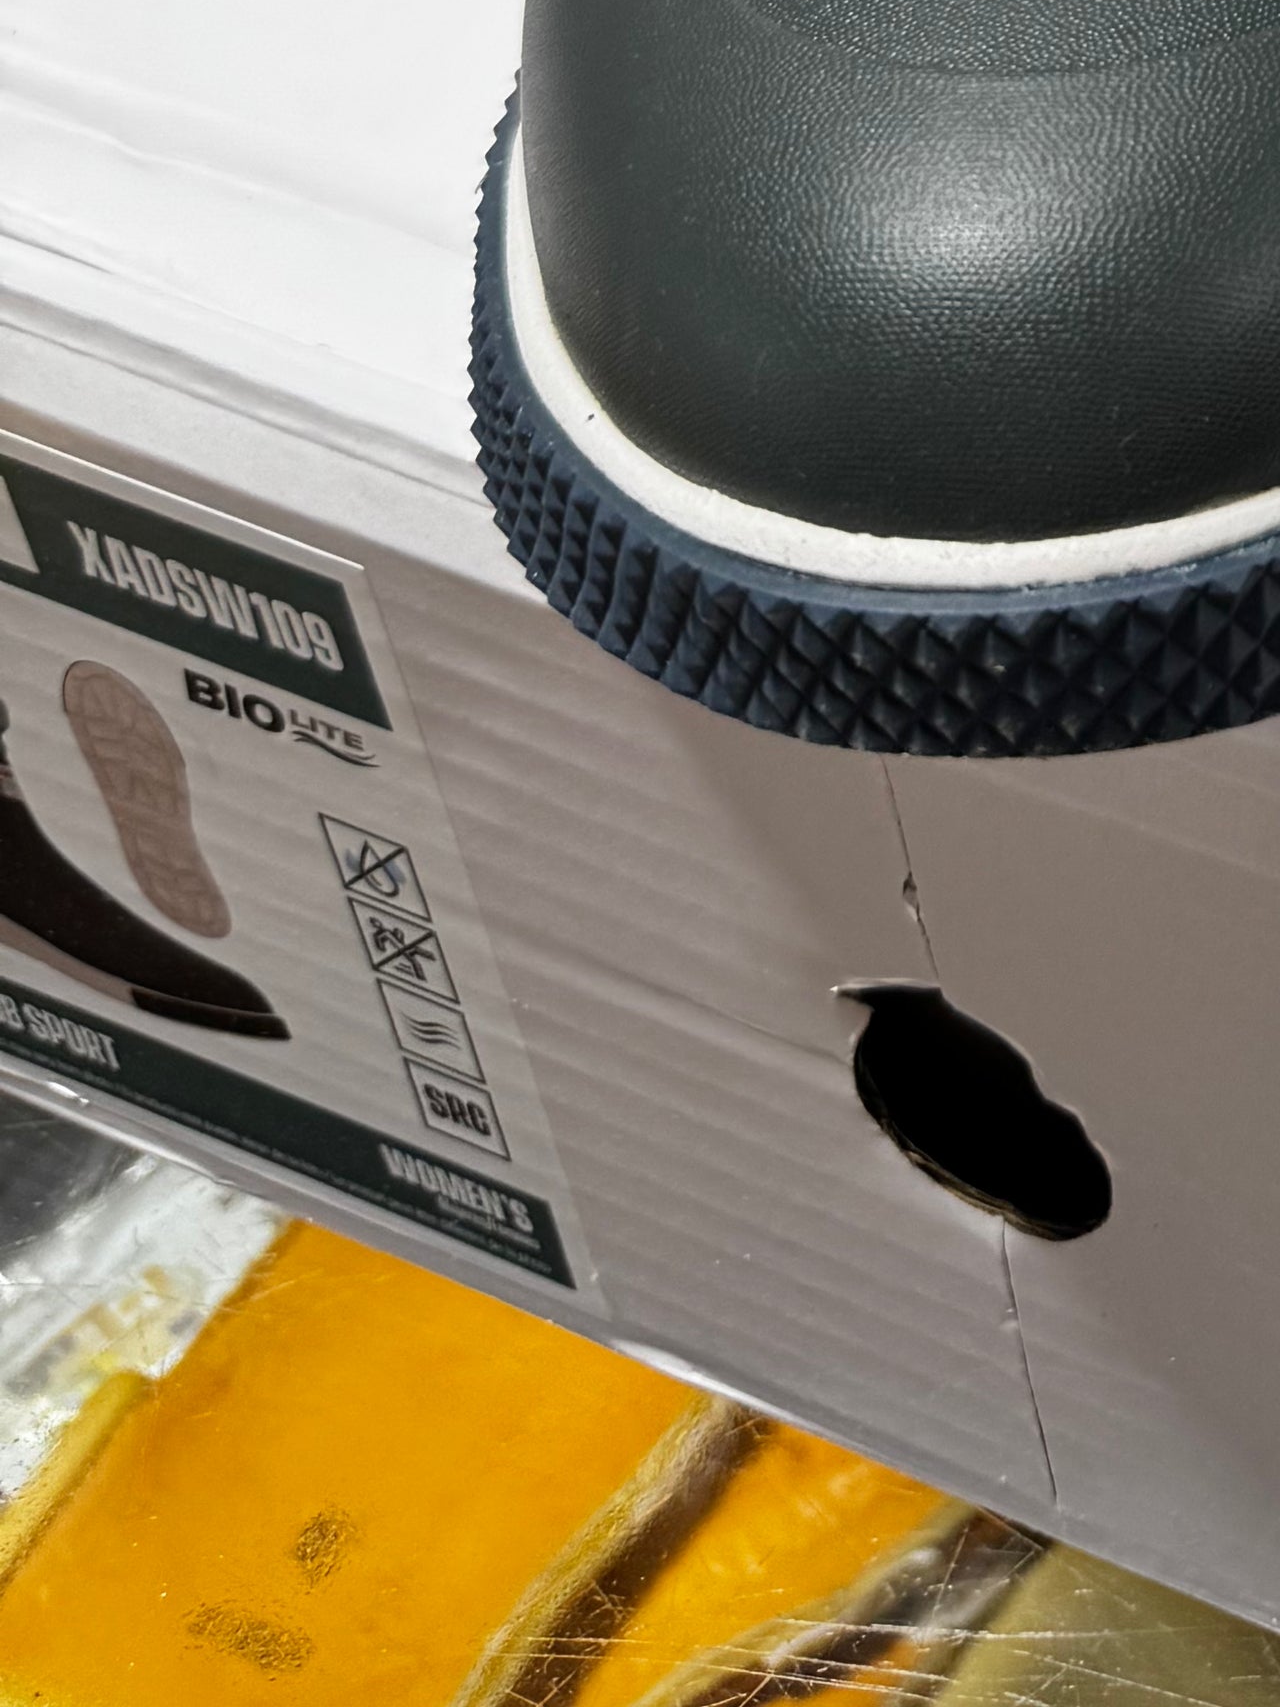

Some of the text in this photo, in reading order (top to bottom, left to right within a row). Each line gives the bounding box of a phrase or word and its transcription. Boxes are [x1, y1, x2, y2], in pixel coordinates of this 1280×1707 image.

[66, 520, 344, 672] XADSW109
[22, 1002, 120, 1071] SPORT
[423, 1083, 491, 1137] SRC
[379, 1143, 534, 1234] WOMEN'S
